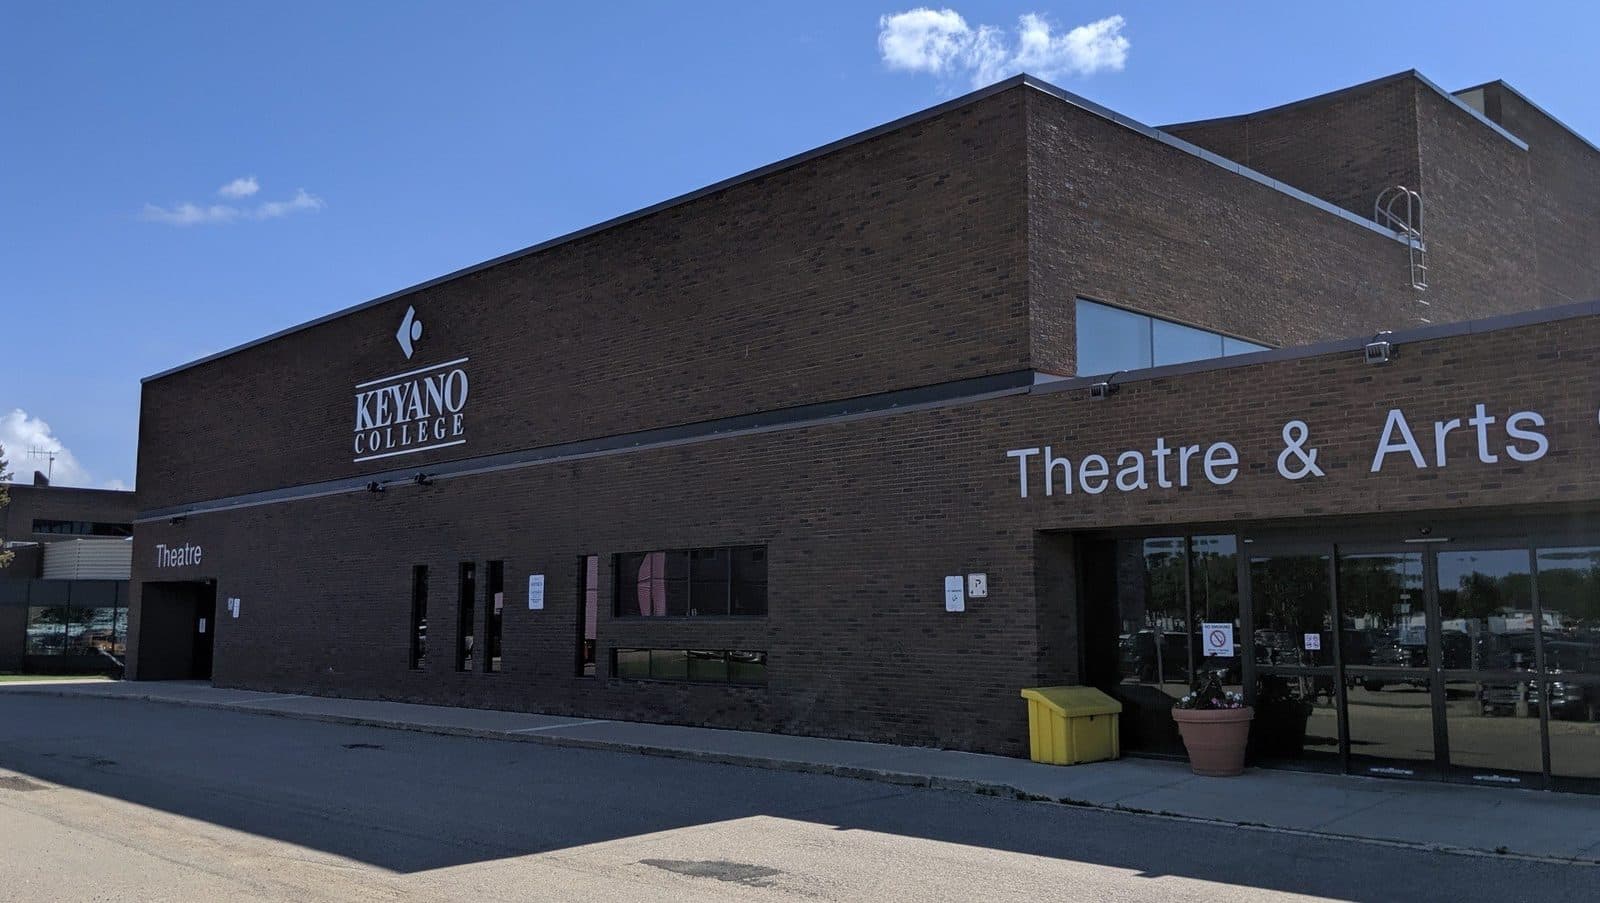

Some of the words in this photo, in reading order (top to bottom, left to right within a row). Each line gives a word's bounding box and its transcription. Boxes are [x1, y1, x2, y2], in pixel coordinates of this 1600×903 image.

[354, 369, 468, 432] KEYANO
[354, 413, 465, 454] COLLEGE
[1006, 437, 1240, 499] Theatre
[1276, 420, 1326, 481] &
[1370, 403, 1550, 473] Arts
[156, 542, 202, 568] Theatre
